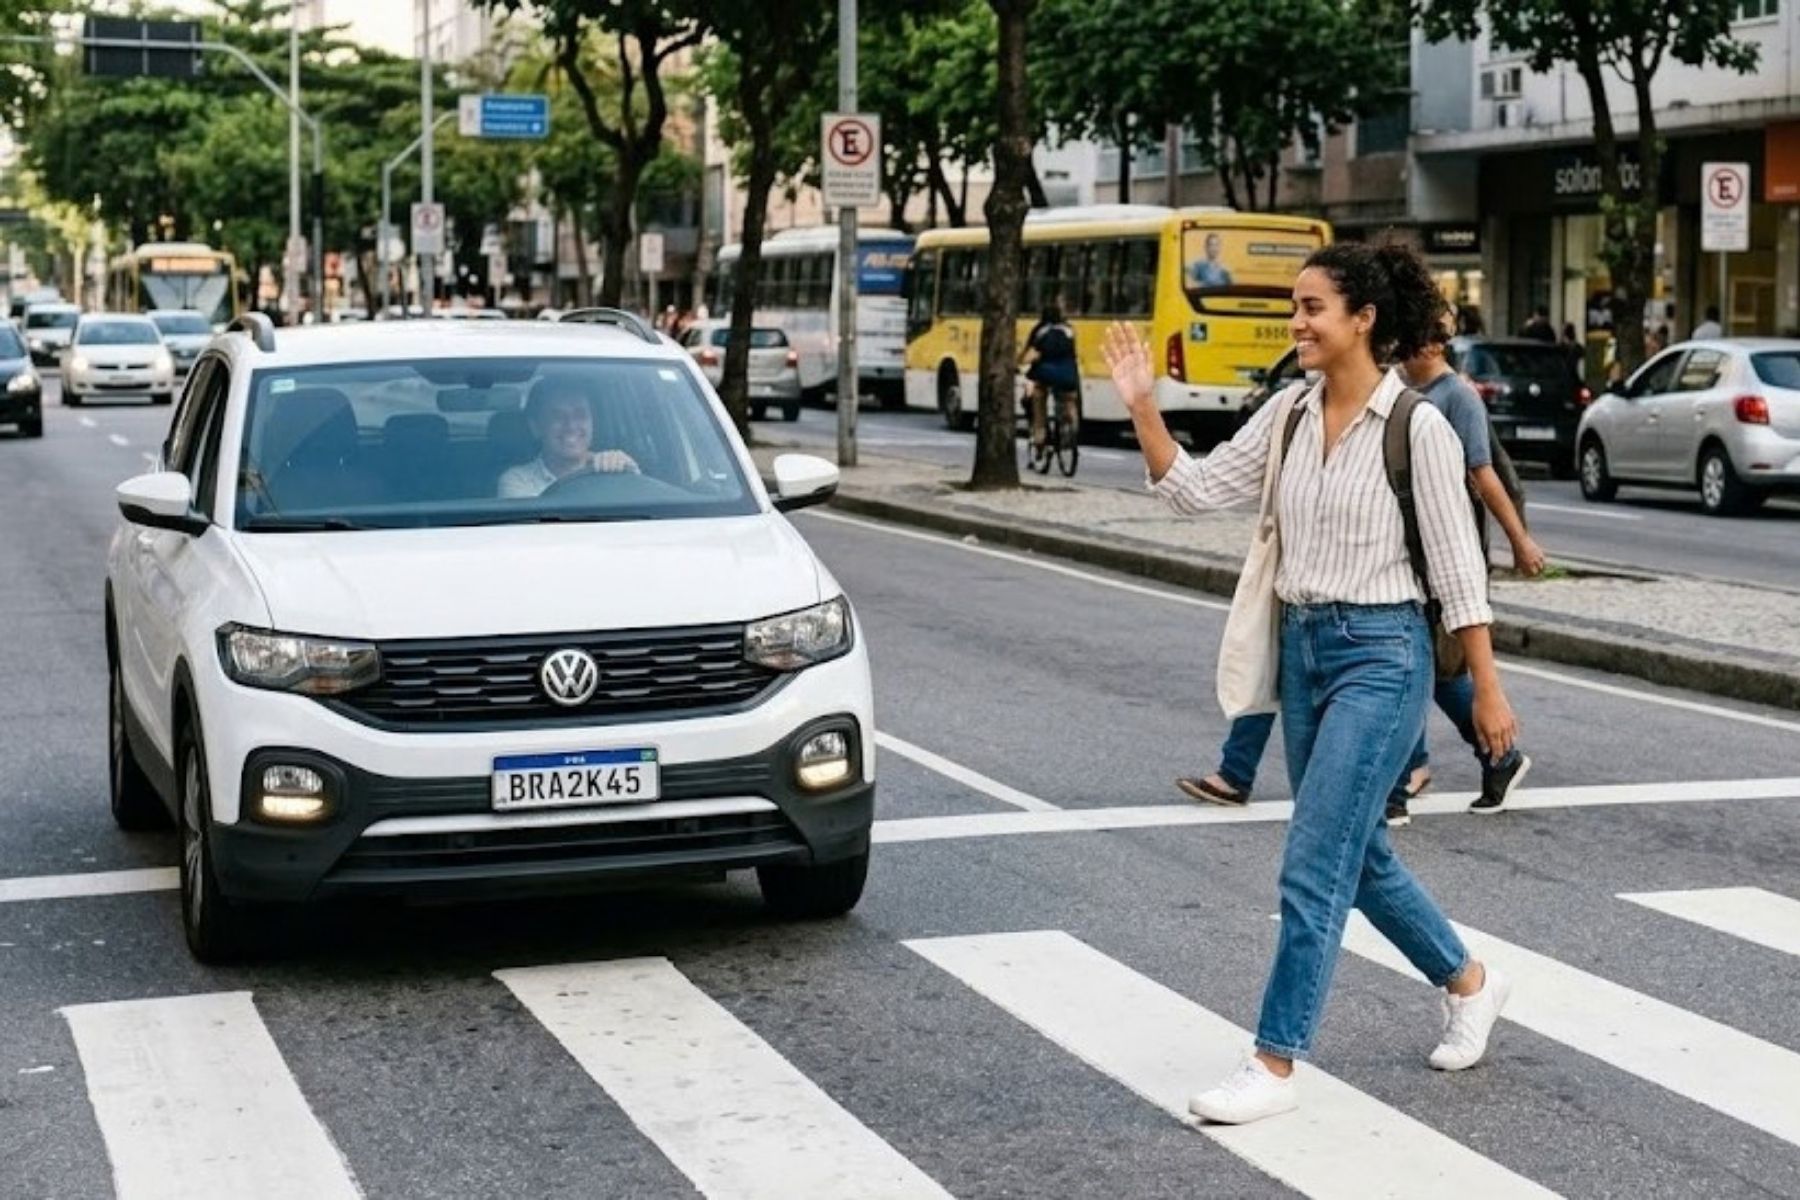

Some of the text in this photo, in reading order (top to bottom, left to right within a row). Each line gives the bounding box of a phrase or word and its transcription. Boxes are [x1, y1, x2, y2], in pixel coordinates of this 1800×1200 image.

[843, 129, 859, 155] E
[1718, 176, 1733, 200] E
[543, 651, 596, 702] VW
[510, 766, 640, 801] BRA2K45
